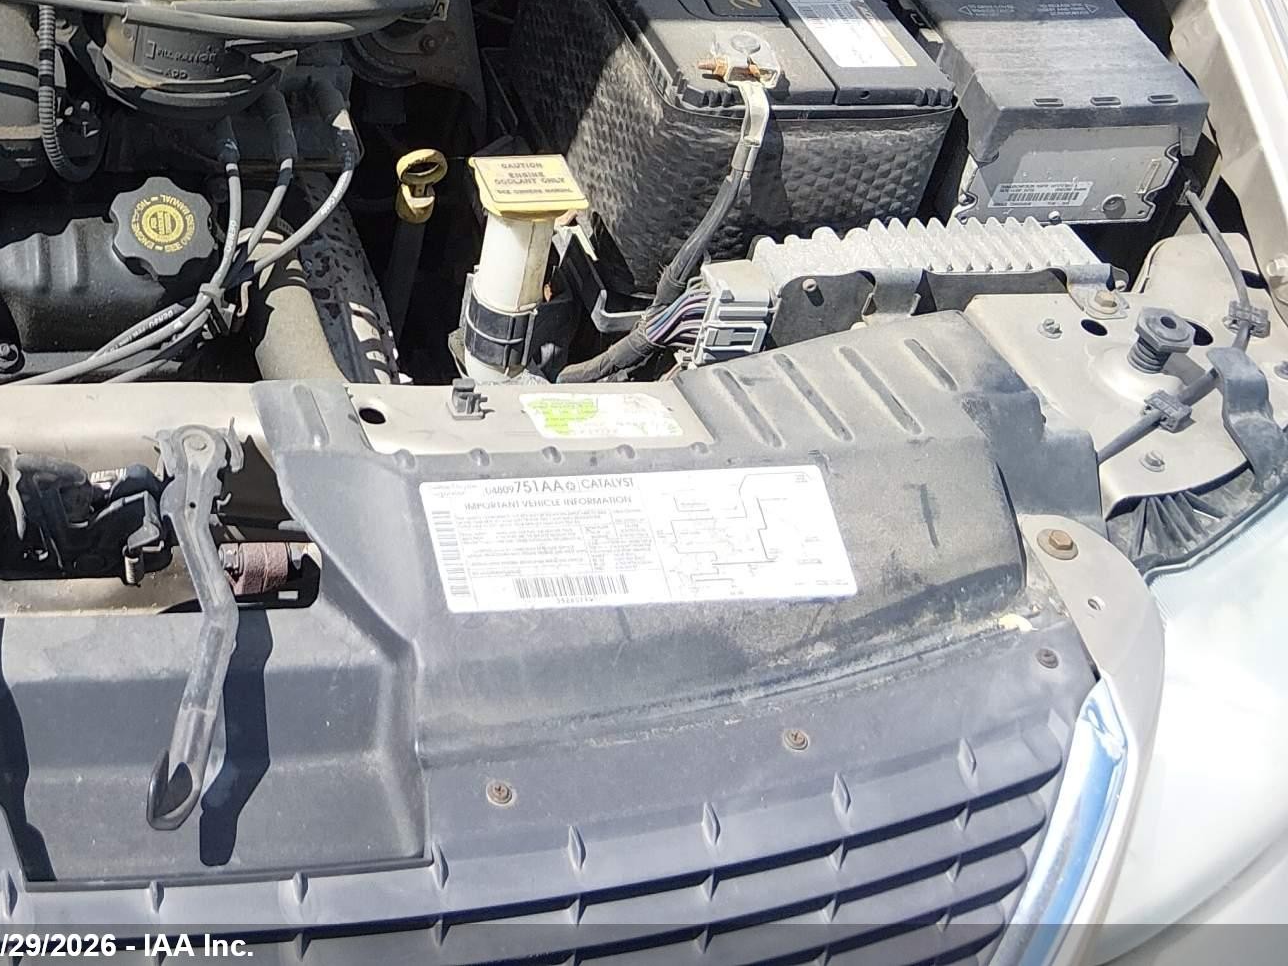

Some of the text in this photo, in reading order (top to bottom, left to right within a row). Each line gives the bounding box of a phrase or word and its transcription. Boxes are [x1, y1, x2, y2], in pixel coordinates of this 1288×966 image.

[136, 198, 152, 211] OIL
[159, 194, 191, 216] MANUAL
[581, 477, 634, 490] CATALYST
[464, 495, 632, 511] IMPORTANT VEHICLE INFORMATION
